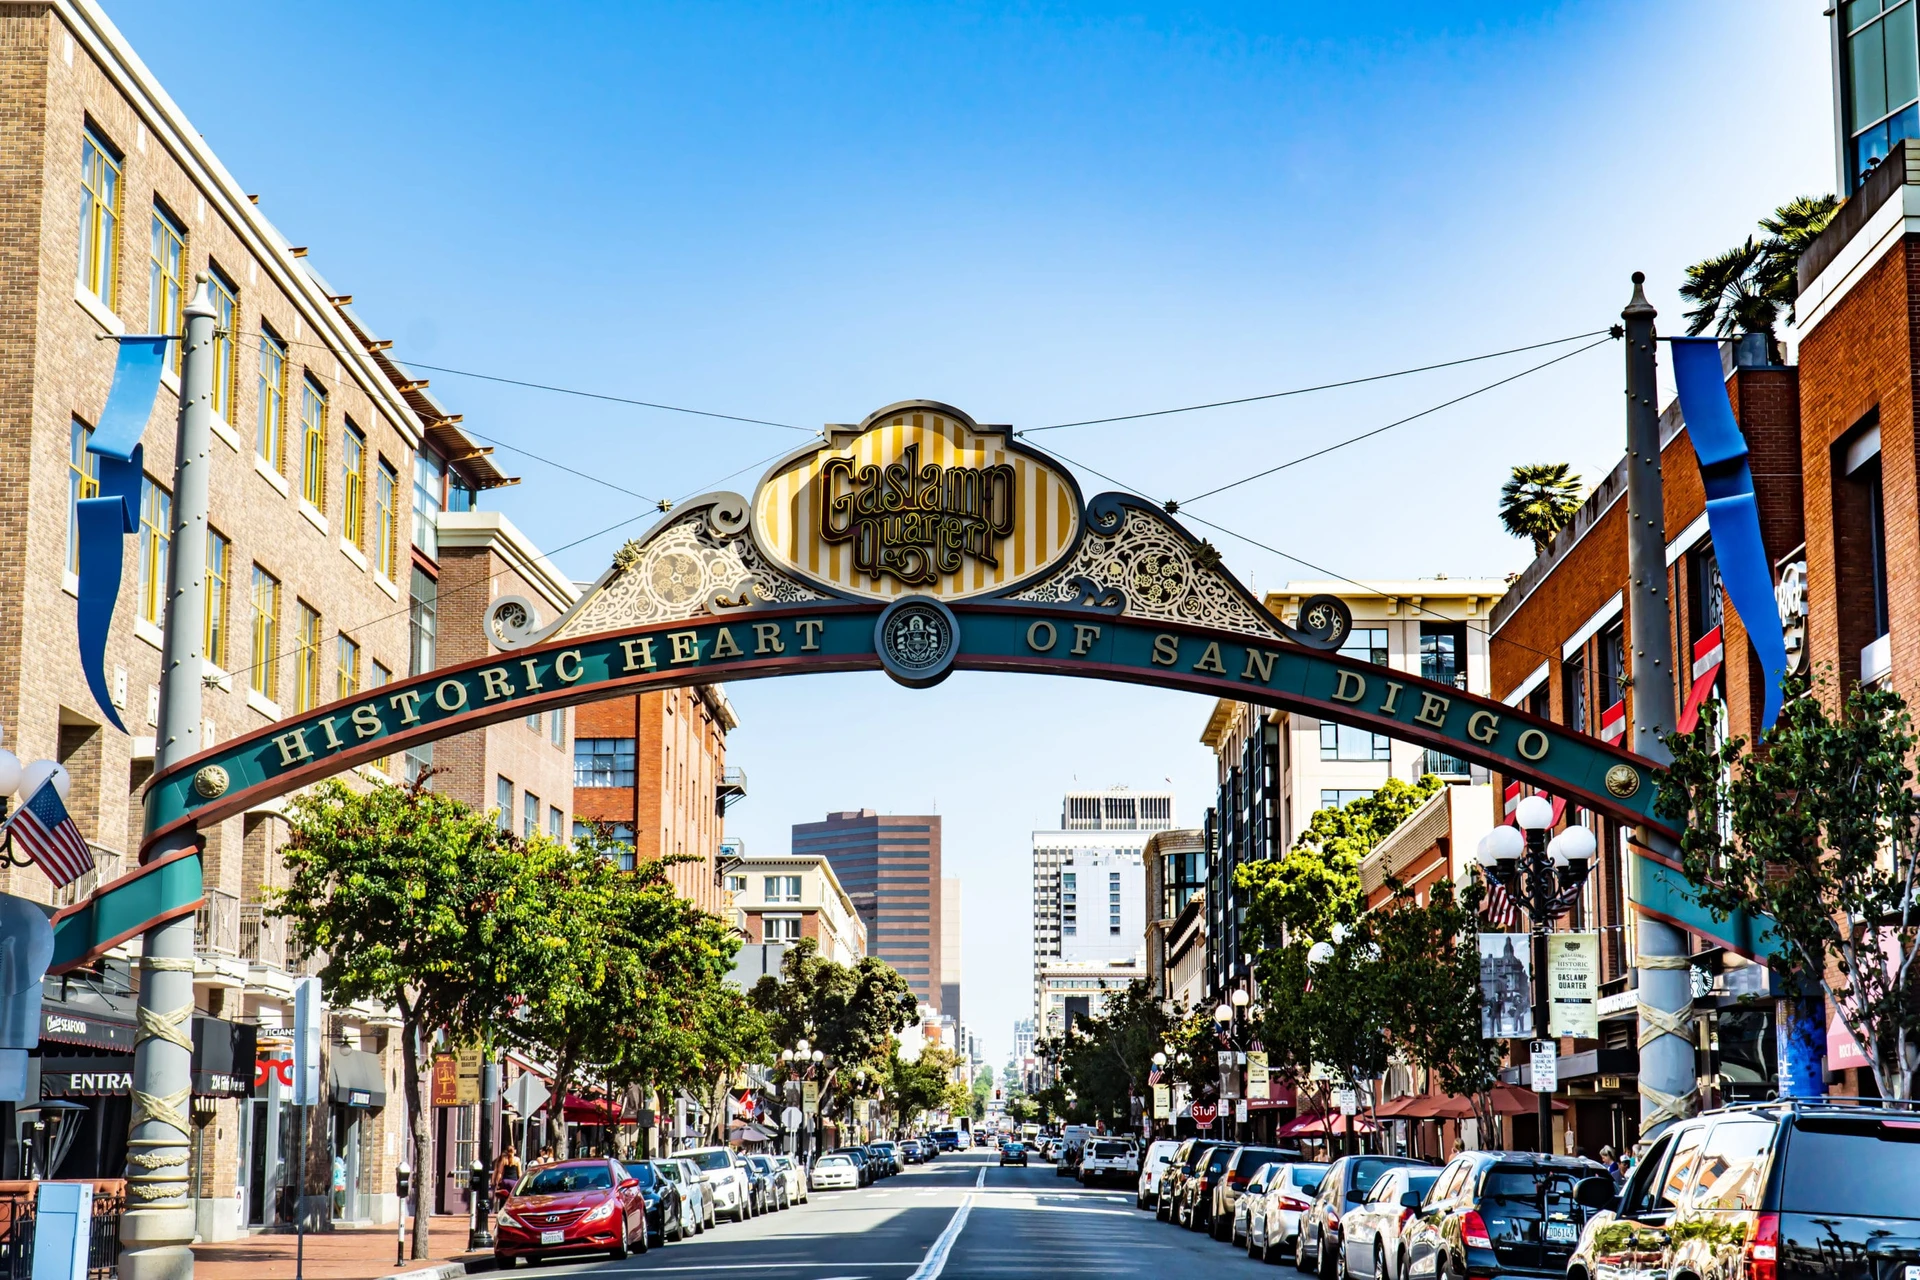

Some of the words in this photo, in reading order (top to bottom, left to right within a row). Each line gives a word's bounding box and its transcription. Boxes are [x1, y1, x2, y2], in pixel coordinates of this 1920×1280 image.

[819, 442, 1017, 569] Gaslamp
[852, 511, 989, 585] Quarter
[271, 649, 585, 768] HISTORIC
[618, 619, 825, 673] HEART
[1026, 620, 1101, 655] OF
[1151, 633, 1280, 683] SAN
[1331, 668, 1550, 761] DIEGO
[257, 1028, 295, 1036] TICIANS
[70, 1073, 133, 1090] ENTRA
[1547, 1227, 1575, 1238] DD6149
